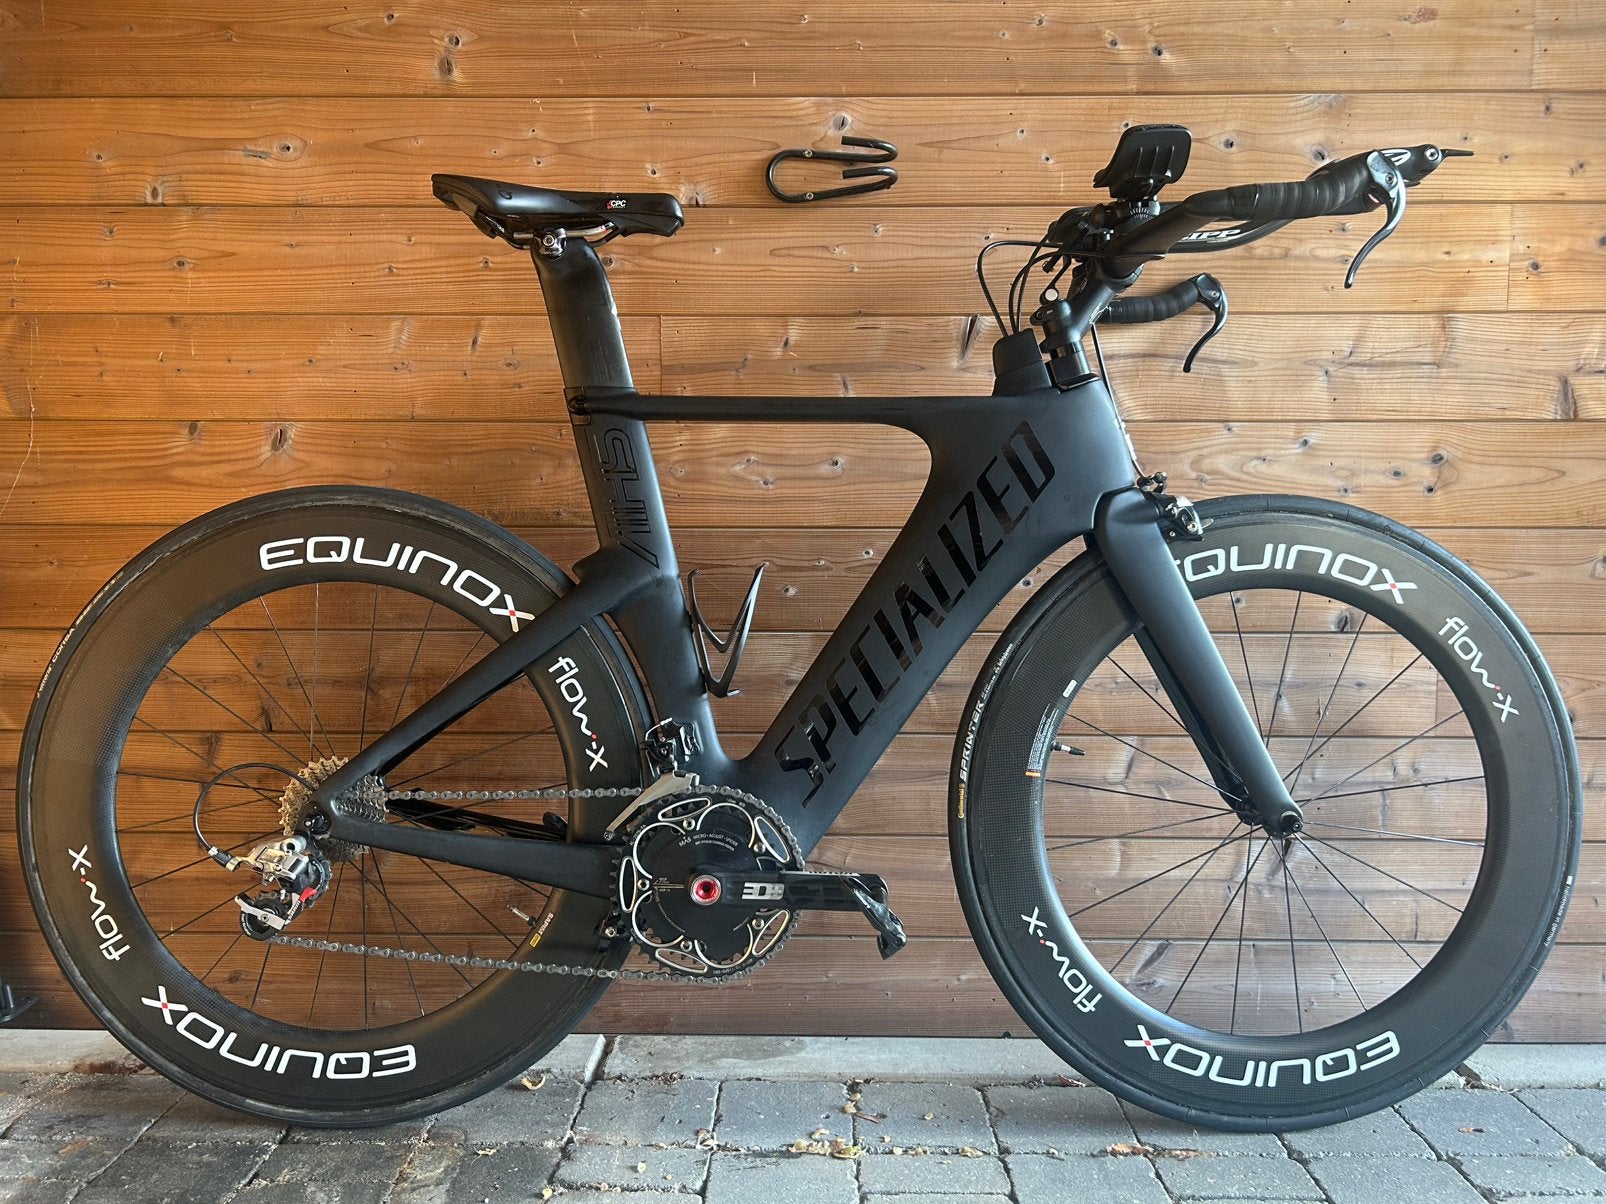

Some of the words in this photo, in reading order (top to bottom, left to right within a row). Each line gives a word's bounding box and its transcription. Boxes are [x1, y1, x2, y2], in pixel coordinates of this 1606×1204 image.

[1179, 229, 1241, 242] IPP
[259, 536, 536, 633] EQUINOX
[774, 420, 1056, 808] SPECIALIZED
[1174, 543, 1418, 605] QUINOX
[959, 700, 985, 782] SPRINTER
[141, 986, 416, 1079] EQUINOX
[1124, 1024, 1400, 1087] EQUINOX
